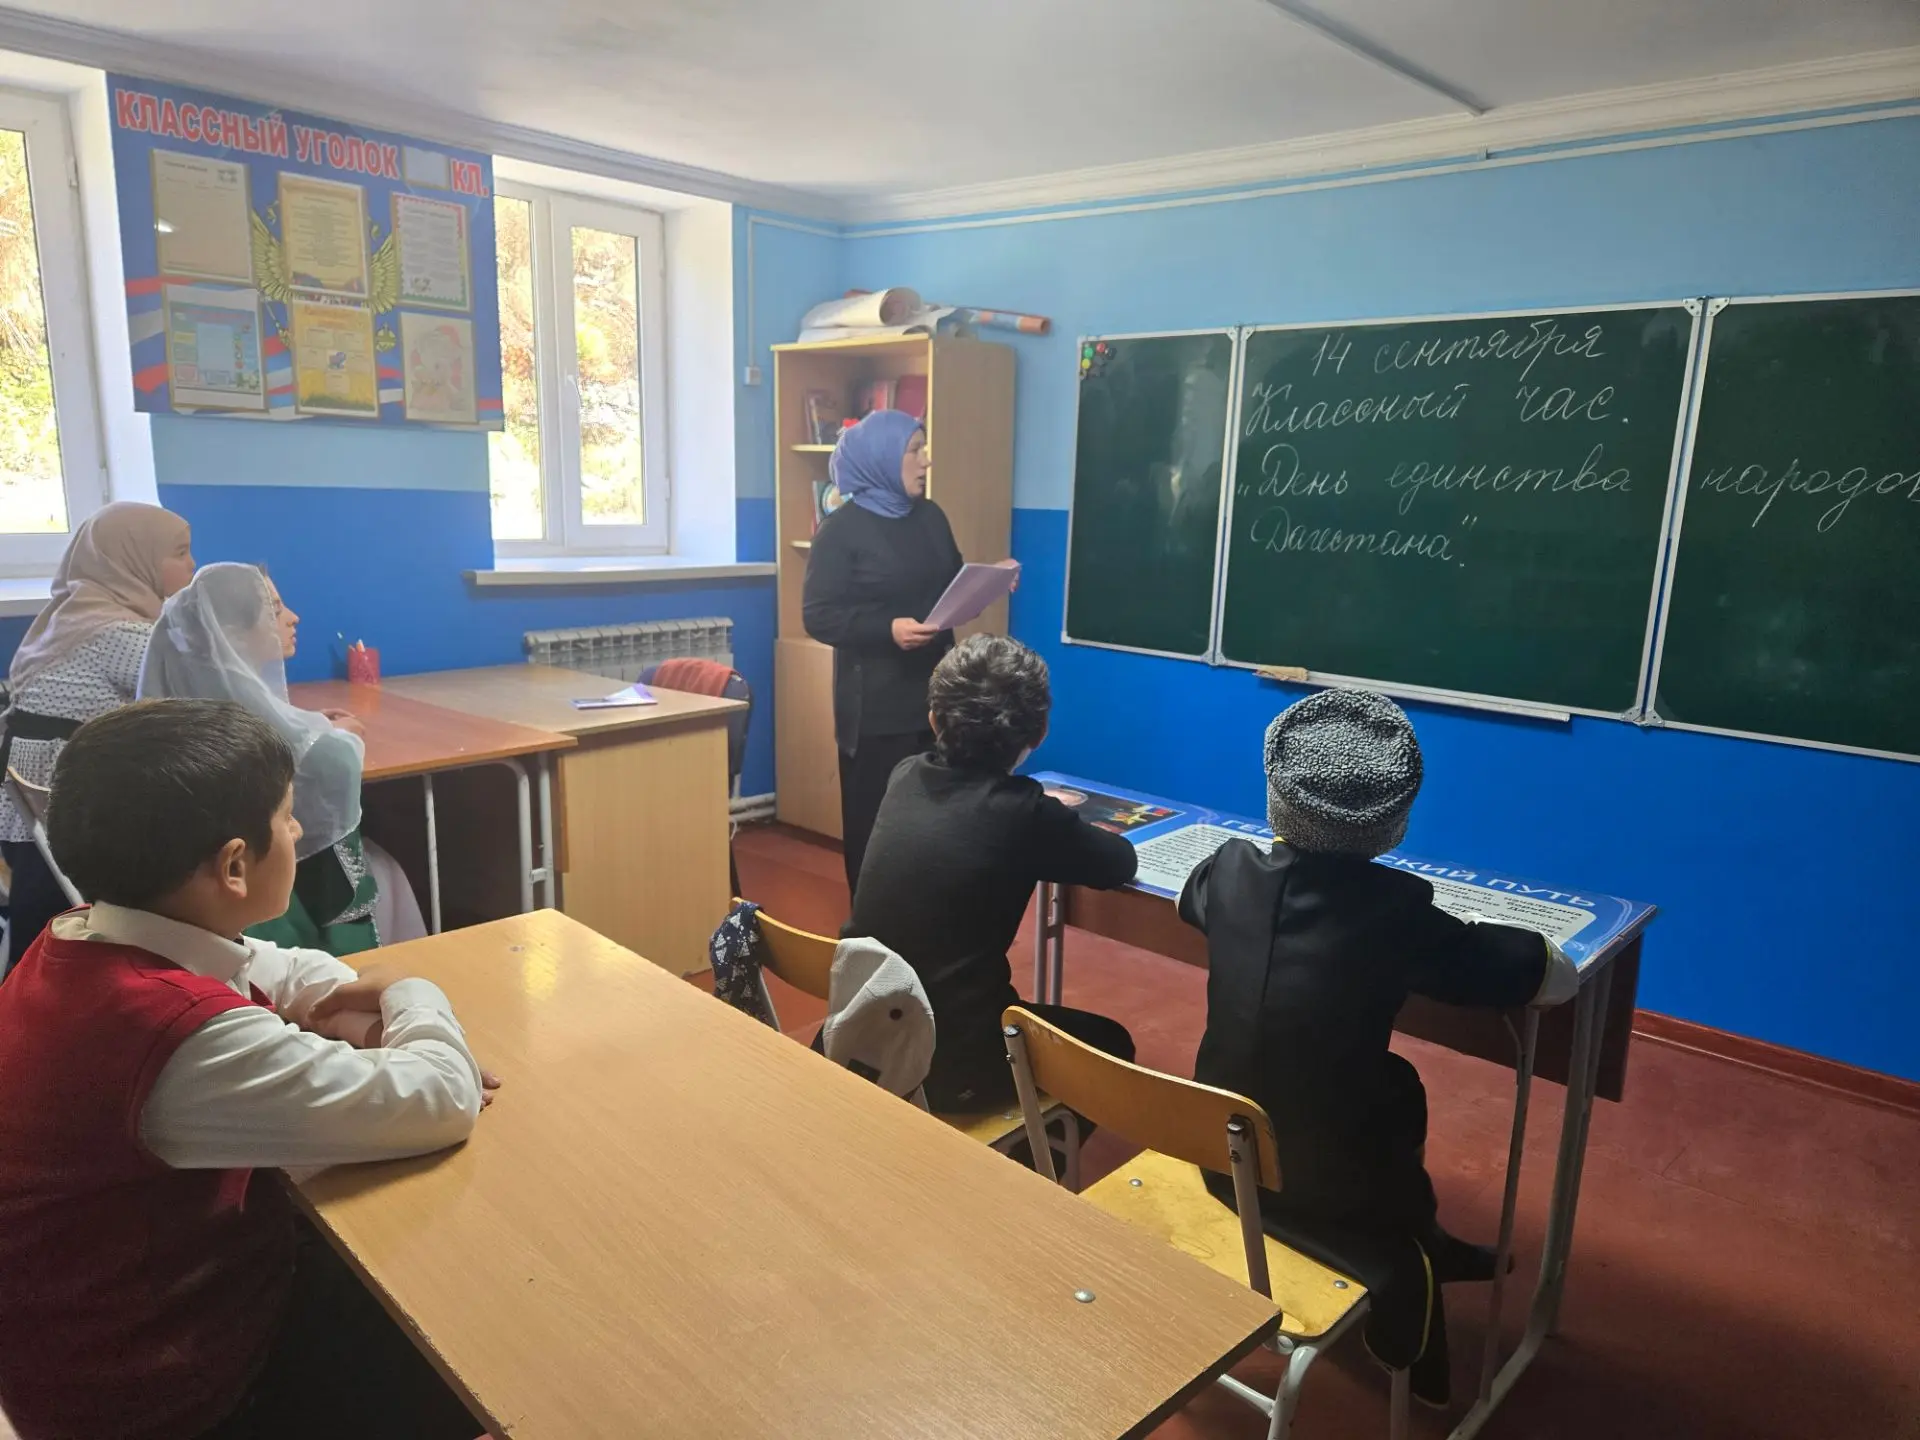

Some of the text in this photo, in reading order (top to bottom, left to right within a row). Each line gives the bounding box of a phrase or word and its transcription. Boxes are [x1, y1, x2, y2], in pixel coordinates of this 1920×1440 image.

[115, 88, 490, 198] КЛАССНЫЙ УГОЛОК КЛ.
[1311, 319, 1606, 382] 14 сентября
[1246, 382, 1630, 437] Классный час.
[1385, 443, 1633, 516] единства
[1486, 878, 1597, 908] ПУТЬ
